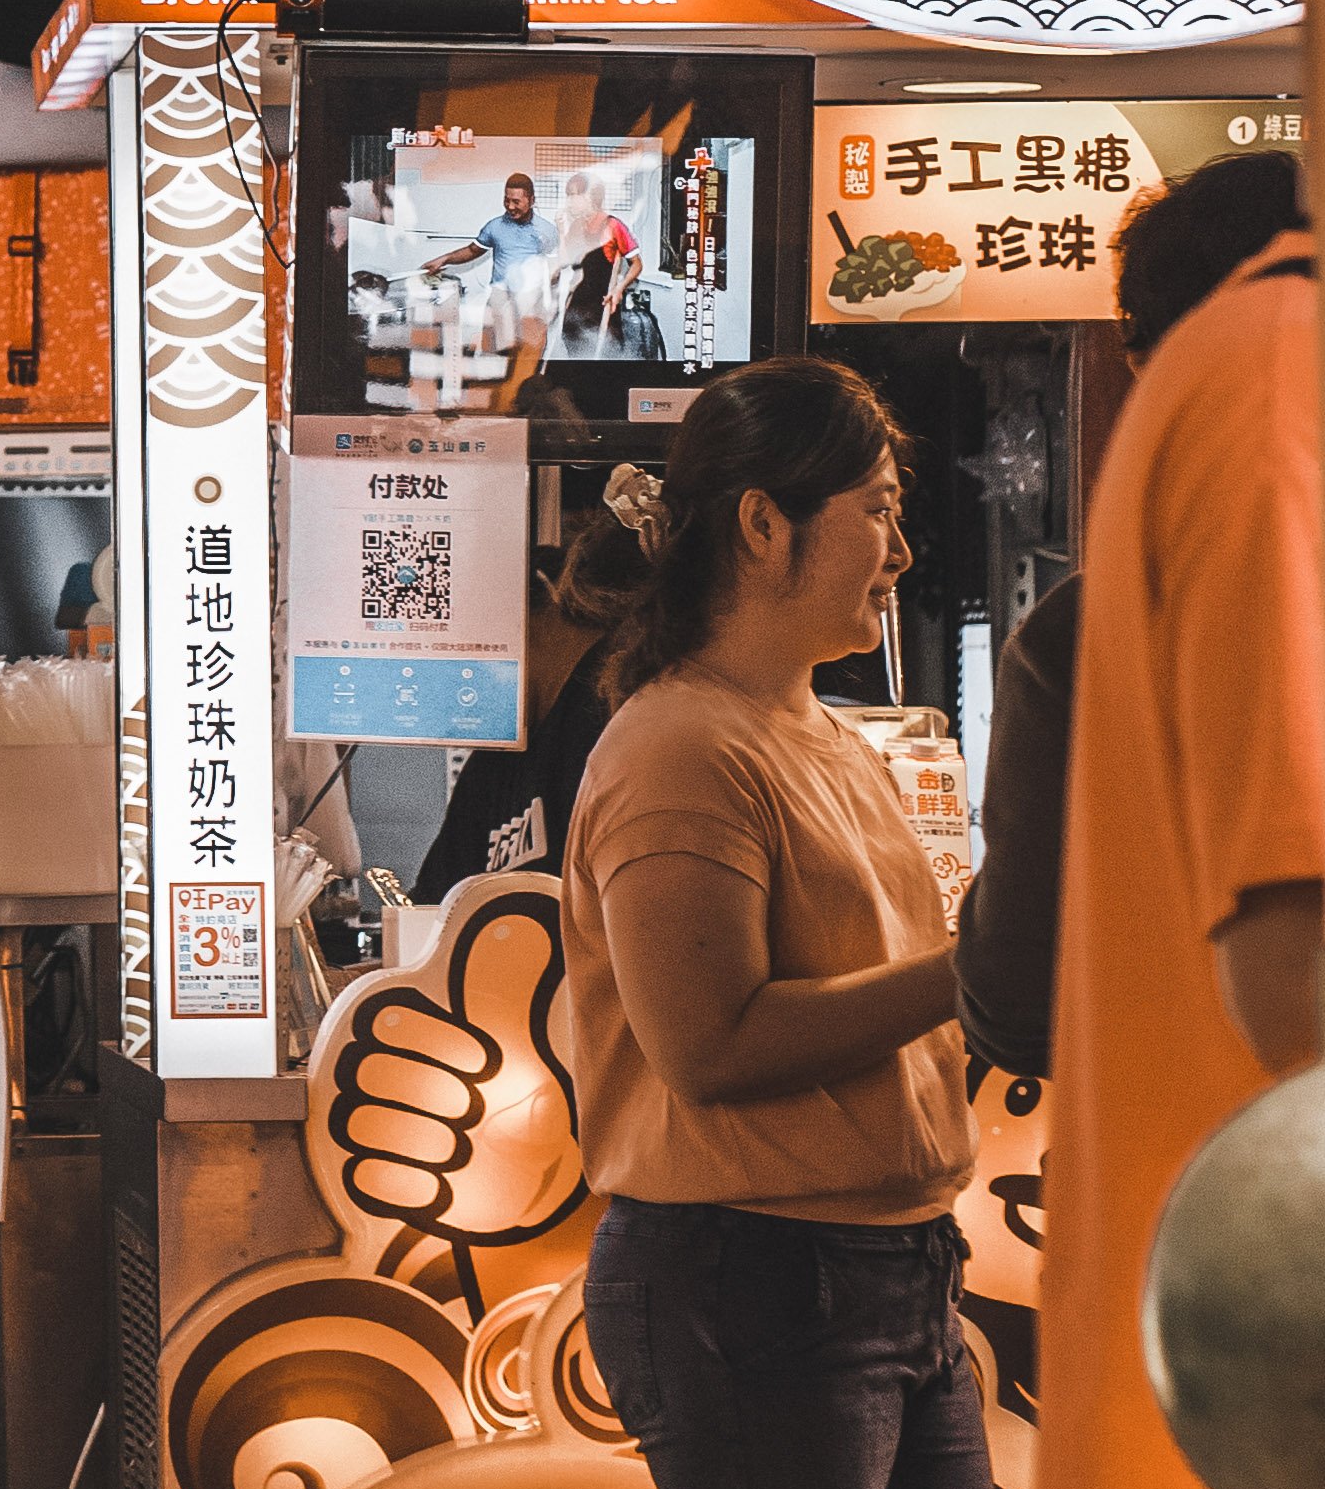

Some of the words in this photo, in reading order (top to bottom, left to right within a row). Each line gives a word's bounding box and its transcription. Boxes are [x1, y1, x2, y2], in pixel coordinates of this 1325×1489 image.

[884, 132, 1132, 196] 手工黑糖
[975, 213, 1096, 272] 珍珠
[368, 472, 449, 500] 付款处
[185, 524, 237, 868] 道地珍珠奶茶
[193, 926, 241, 967] 3%
